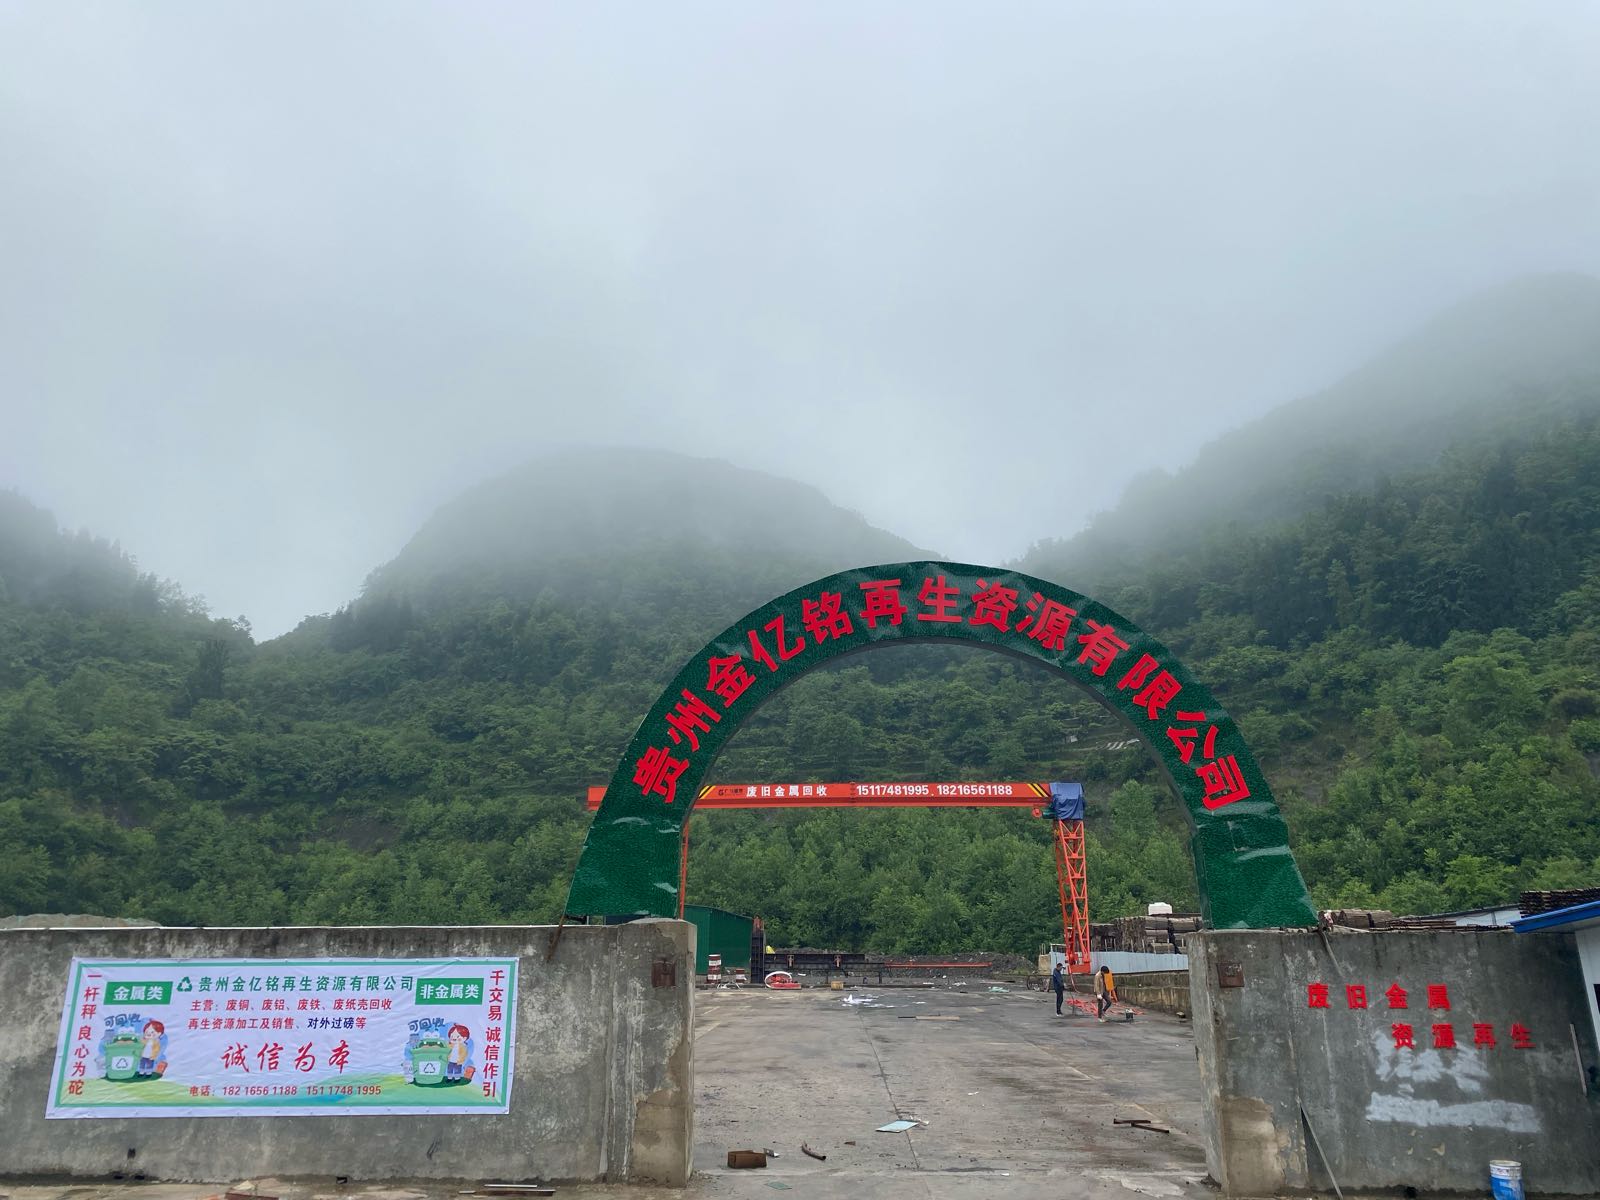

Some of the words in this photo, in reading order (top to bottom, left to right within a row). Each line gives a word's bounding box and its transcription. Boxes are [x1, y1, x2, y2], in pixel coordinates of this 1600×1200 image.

[632, 575, 1250, 811] 贵州金亿铭再生资源有限公司
[746, 785, 828, 798] 废旧金属回收
[198, 976, 414, 993] 贵州金亿铭再生资源有限公司
[420, 983, 480, 999] 非金属类
[113, 985, 164, 1001] 金属类
[1307, 983, 1452, 1011] 废旧金属
[104, 1013, 142, 1028] 可回收
[408, 1016, 445, 1031] 可回收
[1391, 1023, 1537, 1049] 资源再生
[220, 1039, 352, 1074] 诚信为本
[222, 1085, 241, 1096] 182
[245, 1085, 269, 1096] 1656
[272, 1085, 298, 1096] 1188
[306, 1085, 325, 1096] 151
[328, 1085, 354, 1096] 1748
[356, 1085, 382, 1096] 1995
